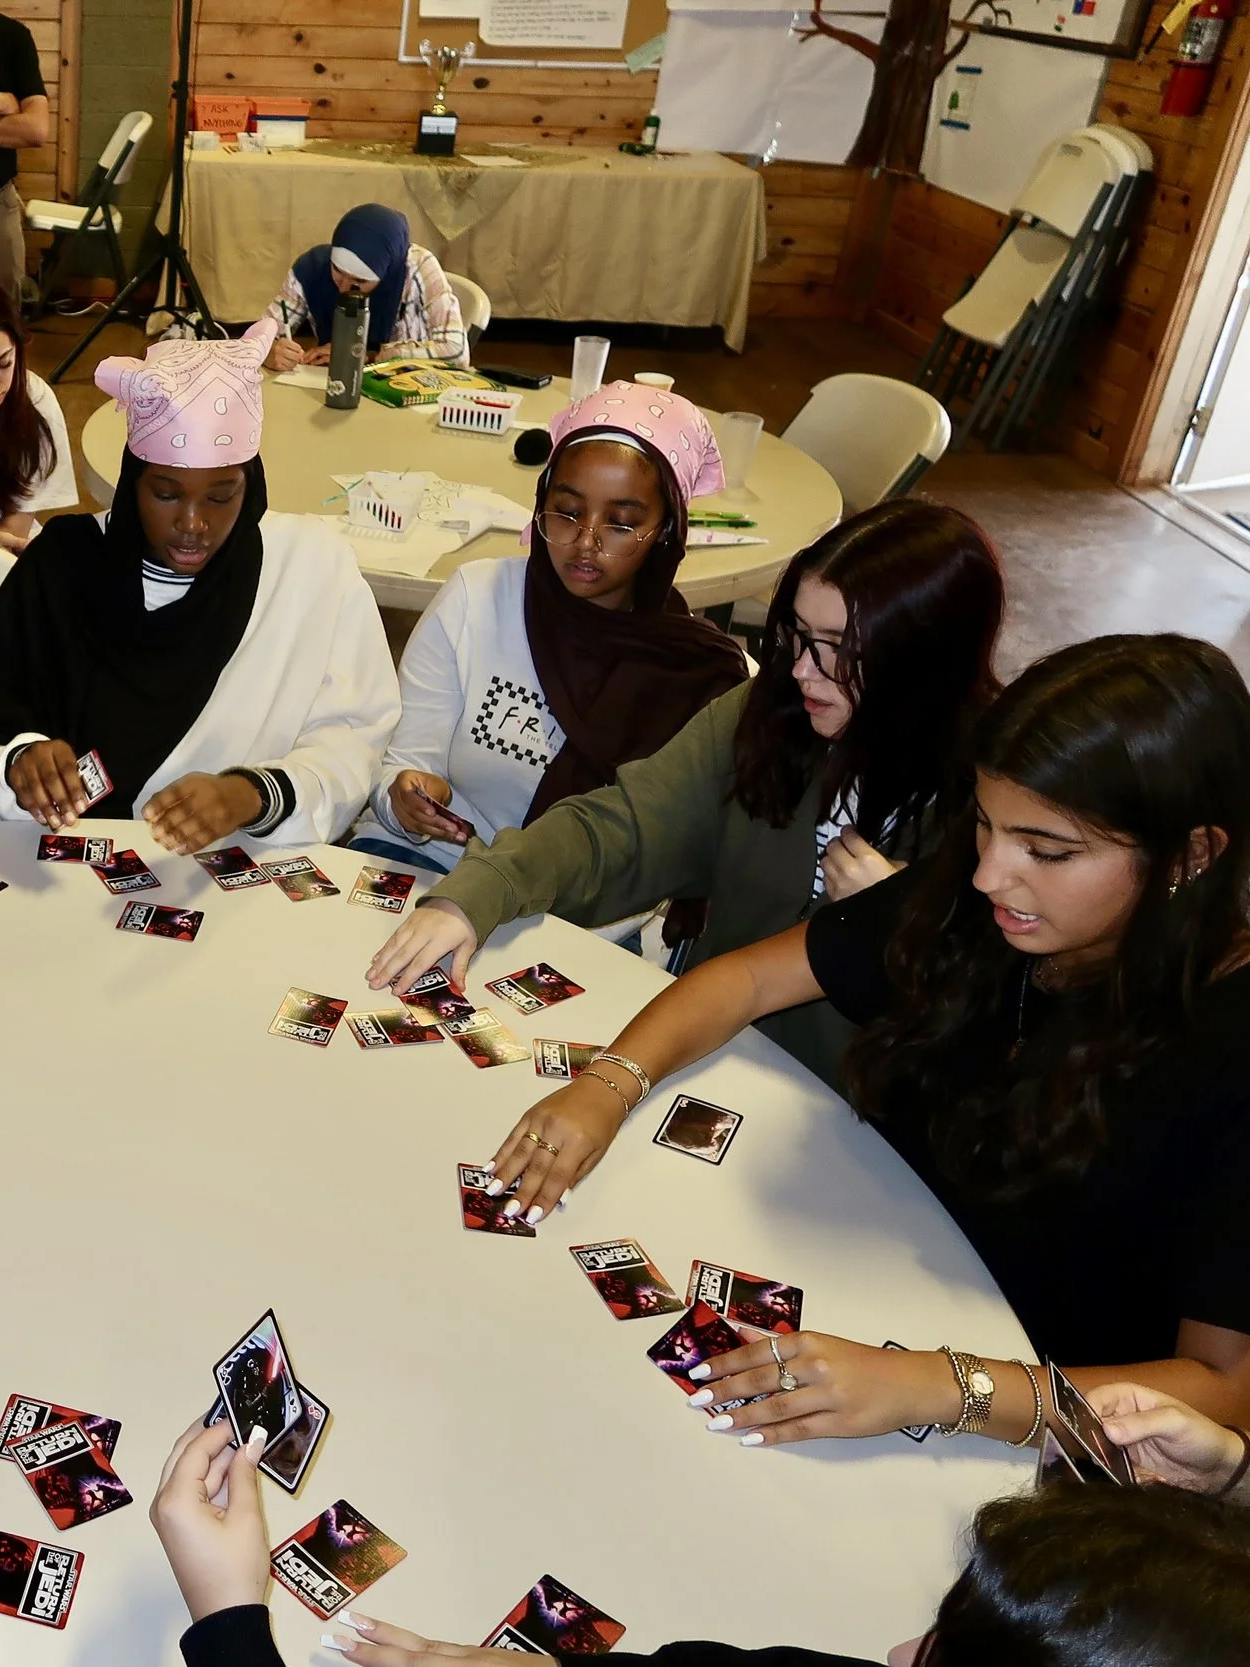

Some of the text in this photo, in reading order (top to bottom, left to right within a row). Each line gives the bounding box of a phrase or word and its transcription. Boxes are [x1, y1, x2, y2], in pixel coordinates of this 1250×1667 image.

[211, 104, 228, 113] ASK
[133, 906, 148, 927] JEDI
[551, 1044, 566, 1072] JEDI
[596, 1248, 641, 1268] JEDI
[706, 1269, 723, 1307] JEDI
[2, 1402, 29, 1454] RTURN
[16, 1426, 79, 1453] RETURN
[33, 1432, 85, 1465] JEDI
[30, 1559, 59, 1617] JEDI
[45, 1554, 71, 1620] RETURN
[275, 1557, 335, 1610] RETURN
[282, 1549, 339, 1597] JEDI
